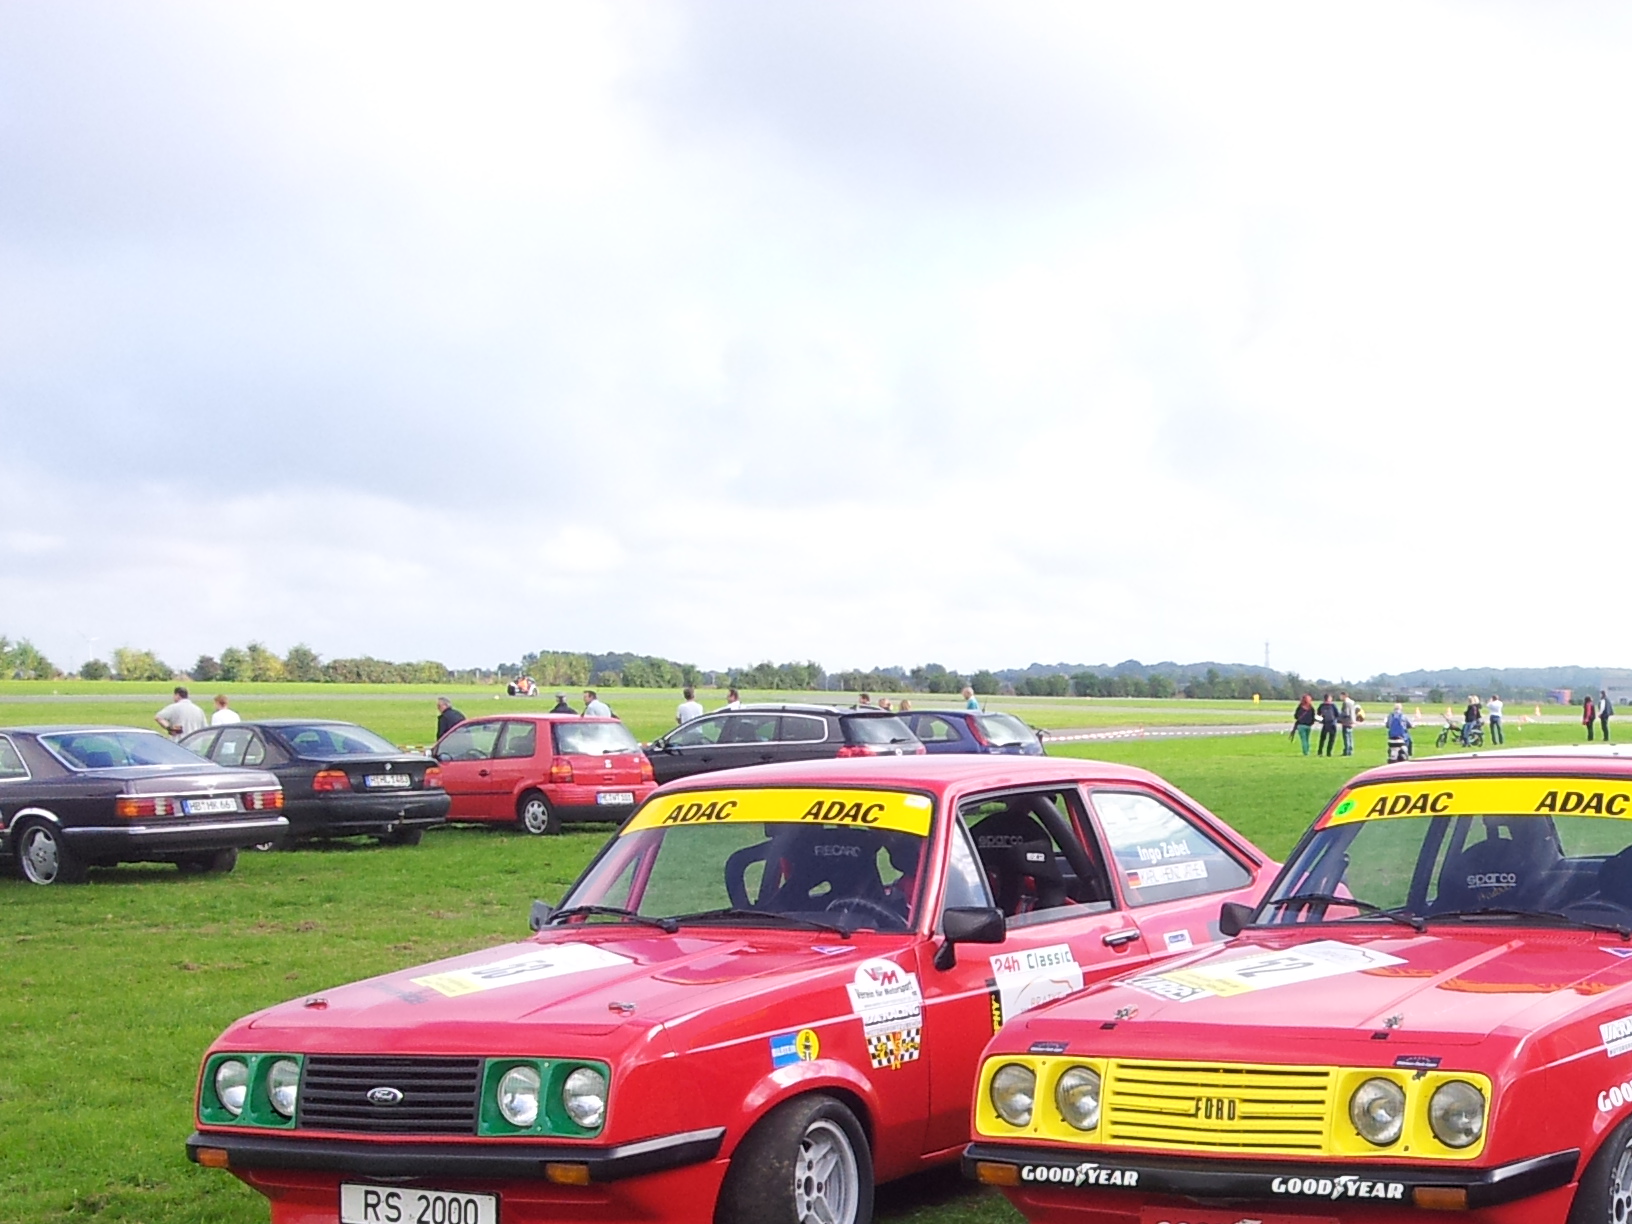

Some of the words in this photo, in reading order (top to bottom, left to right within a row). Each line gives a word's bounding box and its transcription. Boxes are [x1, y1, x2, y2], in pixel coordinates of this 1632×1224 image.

[662, 800, 738, 825] ADAC
[801, 800, 885, 825] ADAC
[1366, 792, 1453, 818] ADAC
[1535, 791, 1631, 816] ADAC
[1136, 845, 1162, 865] Ingo
[1160, 840, 1191, 859] Zabel
[1467, 873, 1517, 888] sparco
[994, 956, 1021, 973] 24h
[1026, 951, 1072, 970] Classic
[1195, 1097, 1237, 1121] FORD
[1021, 1163, 1139, 1187] GOODYEAR
[1271, 1175, 1404, 1200] GOODYEAR
[364, 1189, 402, 1223] RS
